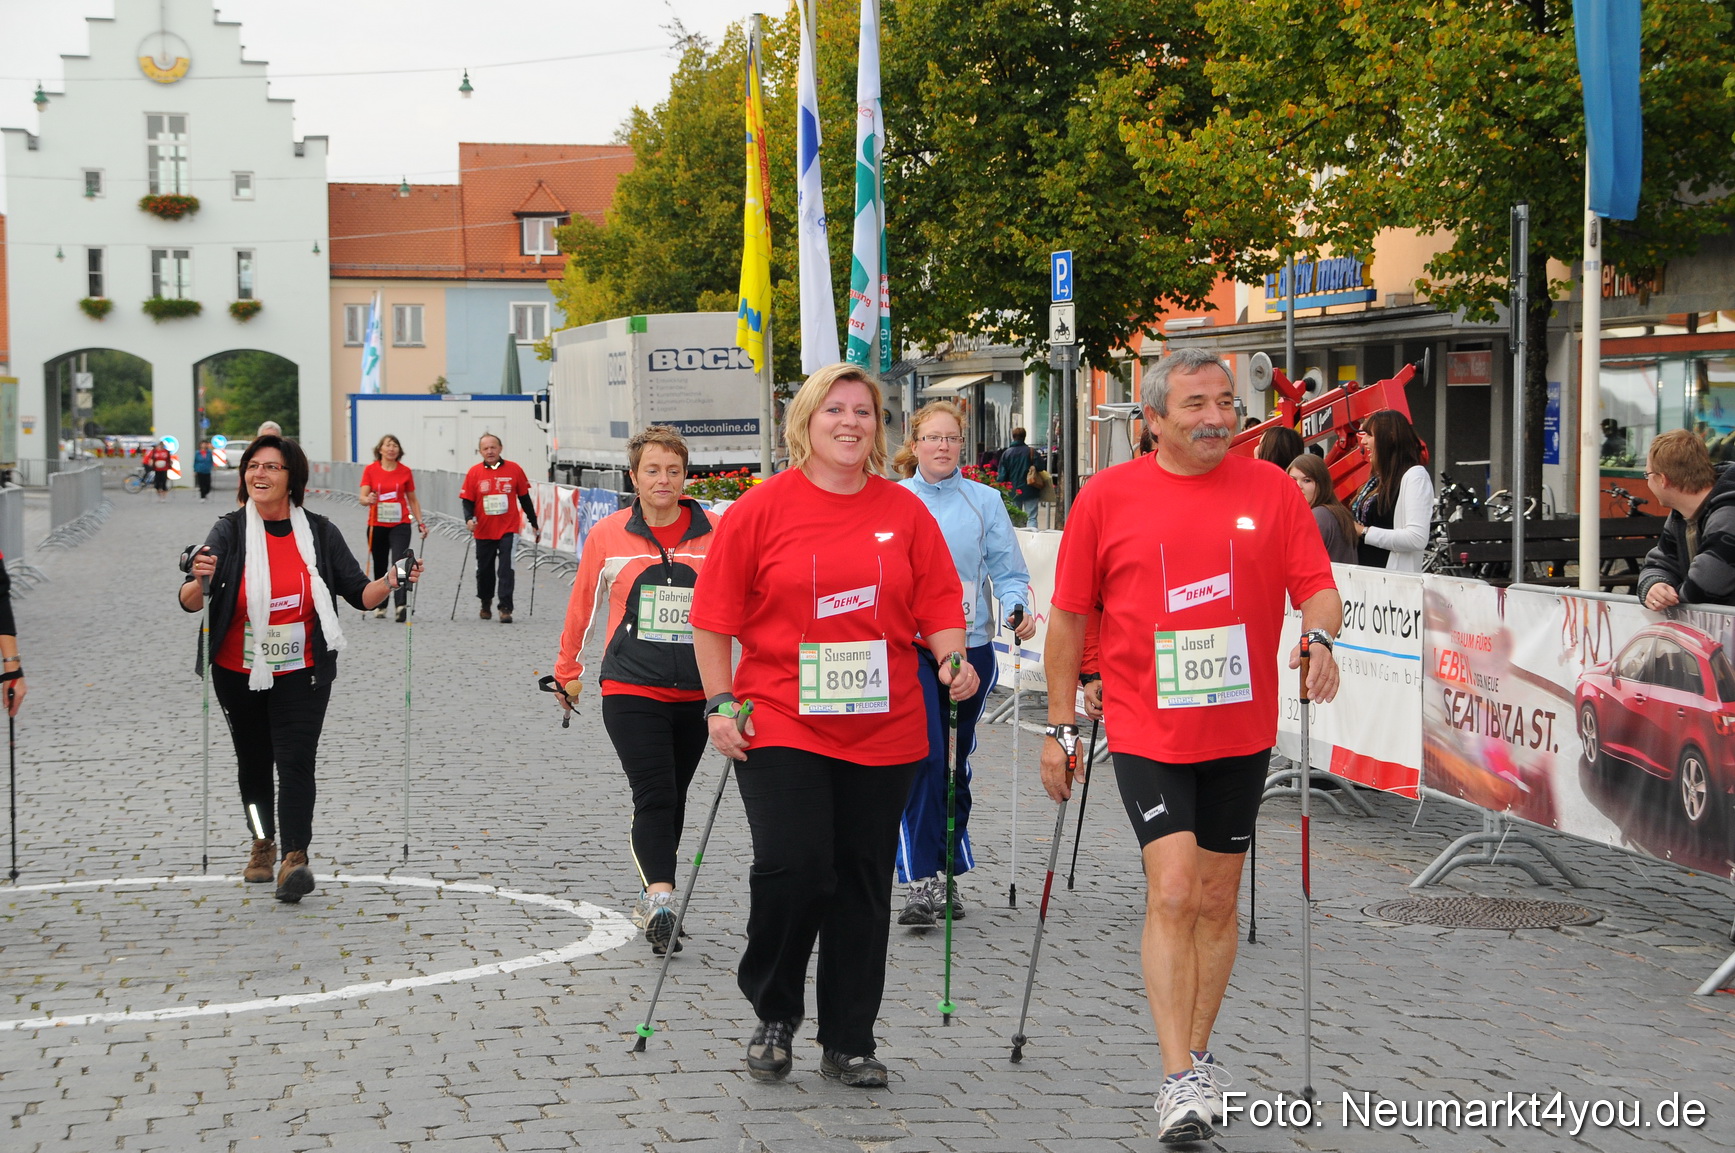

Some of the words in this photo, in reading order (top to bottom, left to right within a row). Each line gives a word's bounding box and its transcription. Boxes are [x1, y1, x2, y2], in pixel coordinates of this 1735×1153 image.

[1056, 258, 1068, 295] P
[648, 347, 754, 371] BOCK
[672, 422, 757, 434] w.bockonline.de
[833, 594, 859, 609] DEHN
[1186, 584, 1213, 601] DEHN
[1338, 591, 1367, 638] erd
[1373, 600, 1421, 639] ortner
[1181, 634, 1215, 651] Josef
[1475, 632, 1492, 652] FÜRS
[825, 649, 871, 662] Susanne
[1185, 655, 1242, 680] 8076
[826, 668, 882, 690] 8094
[1484, 674, 1499, 692] NEUE
[1217, 689, 1251, 699] PFLEIDERER
[1443, 687, 1483, 734] SEAT
[1485, 698, 1525, 747] IBIZA
[1529, 708, 1559, 754] ST.
